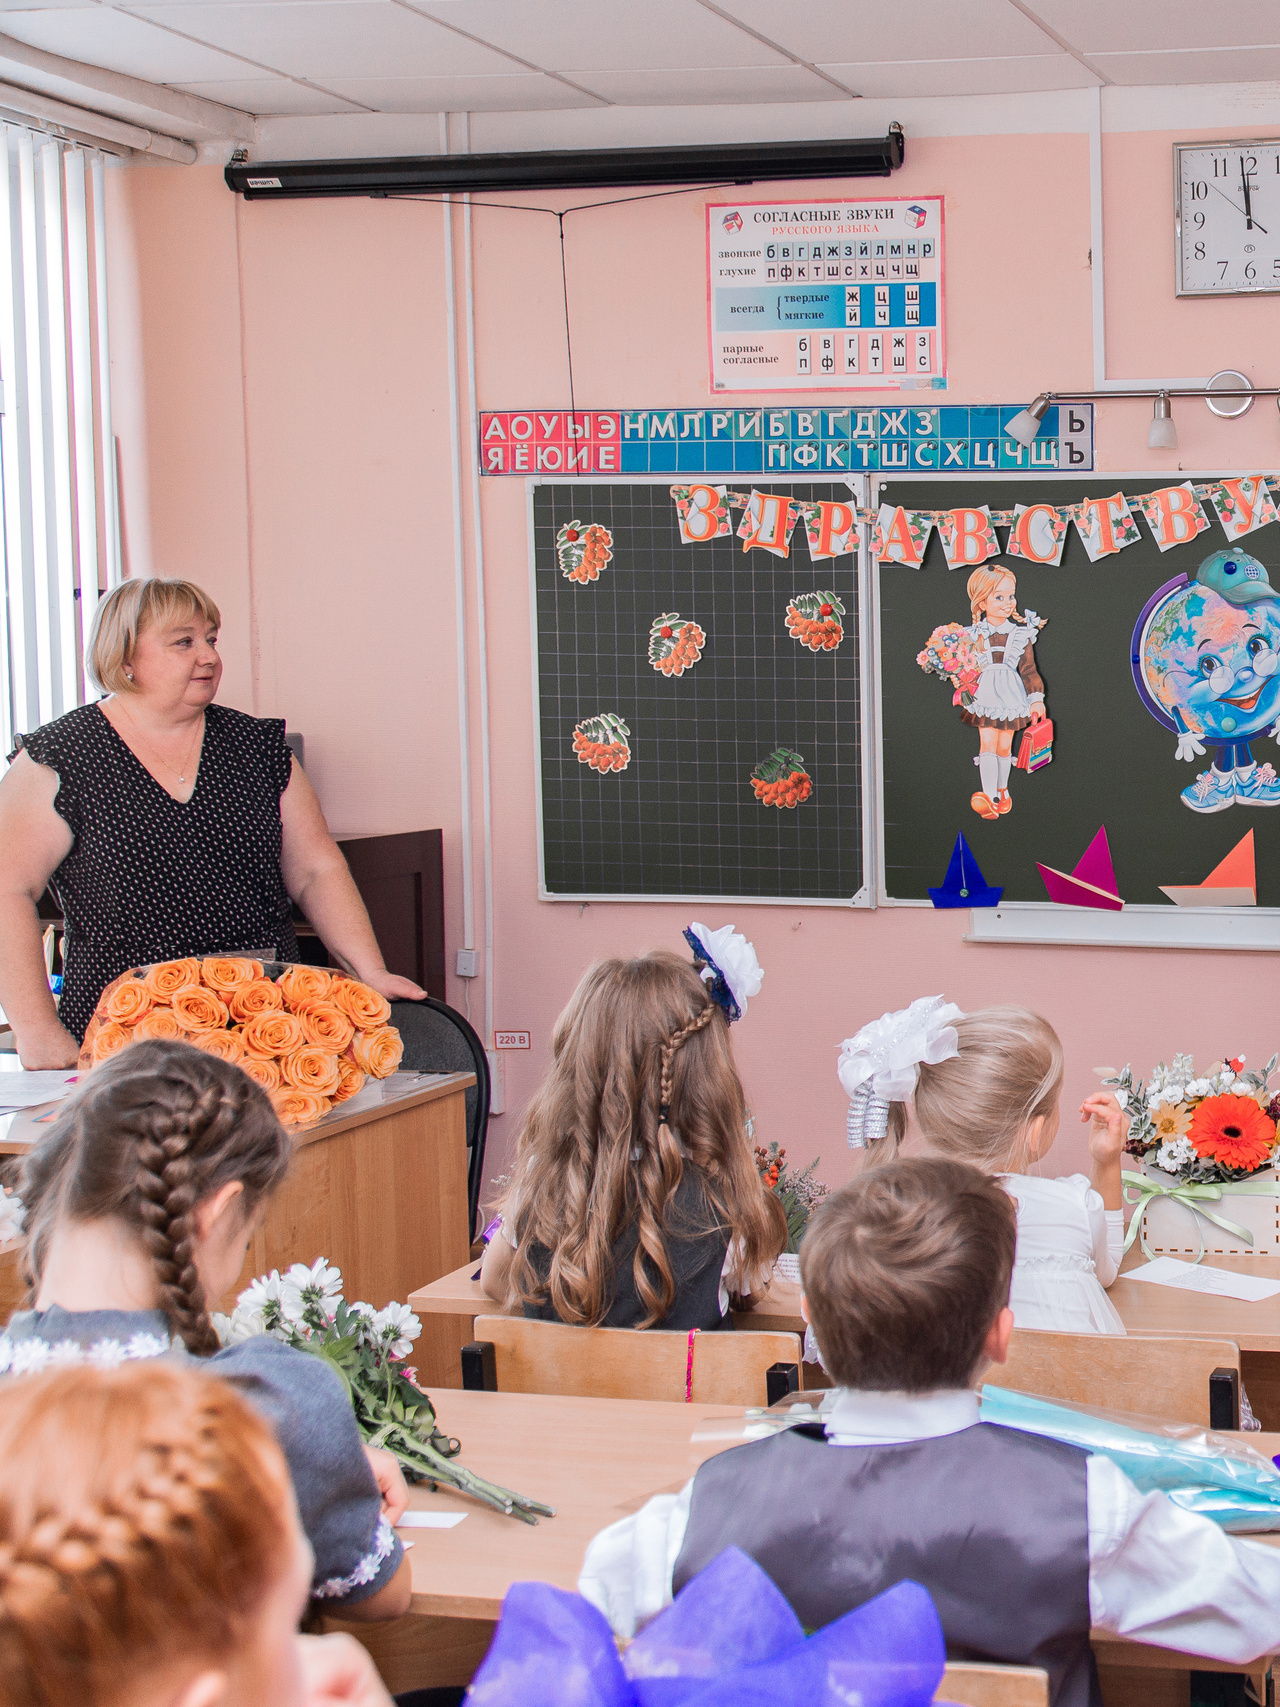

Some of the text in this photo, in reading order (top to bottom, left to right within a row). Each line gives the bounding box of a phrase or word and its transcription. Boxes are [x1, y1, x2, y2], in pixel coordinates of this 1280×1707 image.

[1213, 158, 1227, 177] 11
[1275, 155, 1280, 175] 1
[1190, 181, 1208, 200] 10
[753, 208, 895, 223] СОГЛАСНЫЕ ЗВУКИ
[1194, 212, 1206, 231] 9
[772, 224, 880, 236] РУССКОГО ЯЗЫКА
[718, 249, 762, 259] звонкие
[1194, 241, 1206, 261] 8
[719, 267, 756, 277] глухие
[1217, 261, 1229, 280] 7
[1244, 260, 1257, 280] 6
[784, 294, 830, 304] твердые
[730, 304, 765, 314] всегда
[784, 311, 825, 320] мягкие
[722, 345, 764, 354] парные
[723, 356, 779, 365] согласные
[499, 1036, 516, 1044] 220
